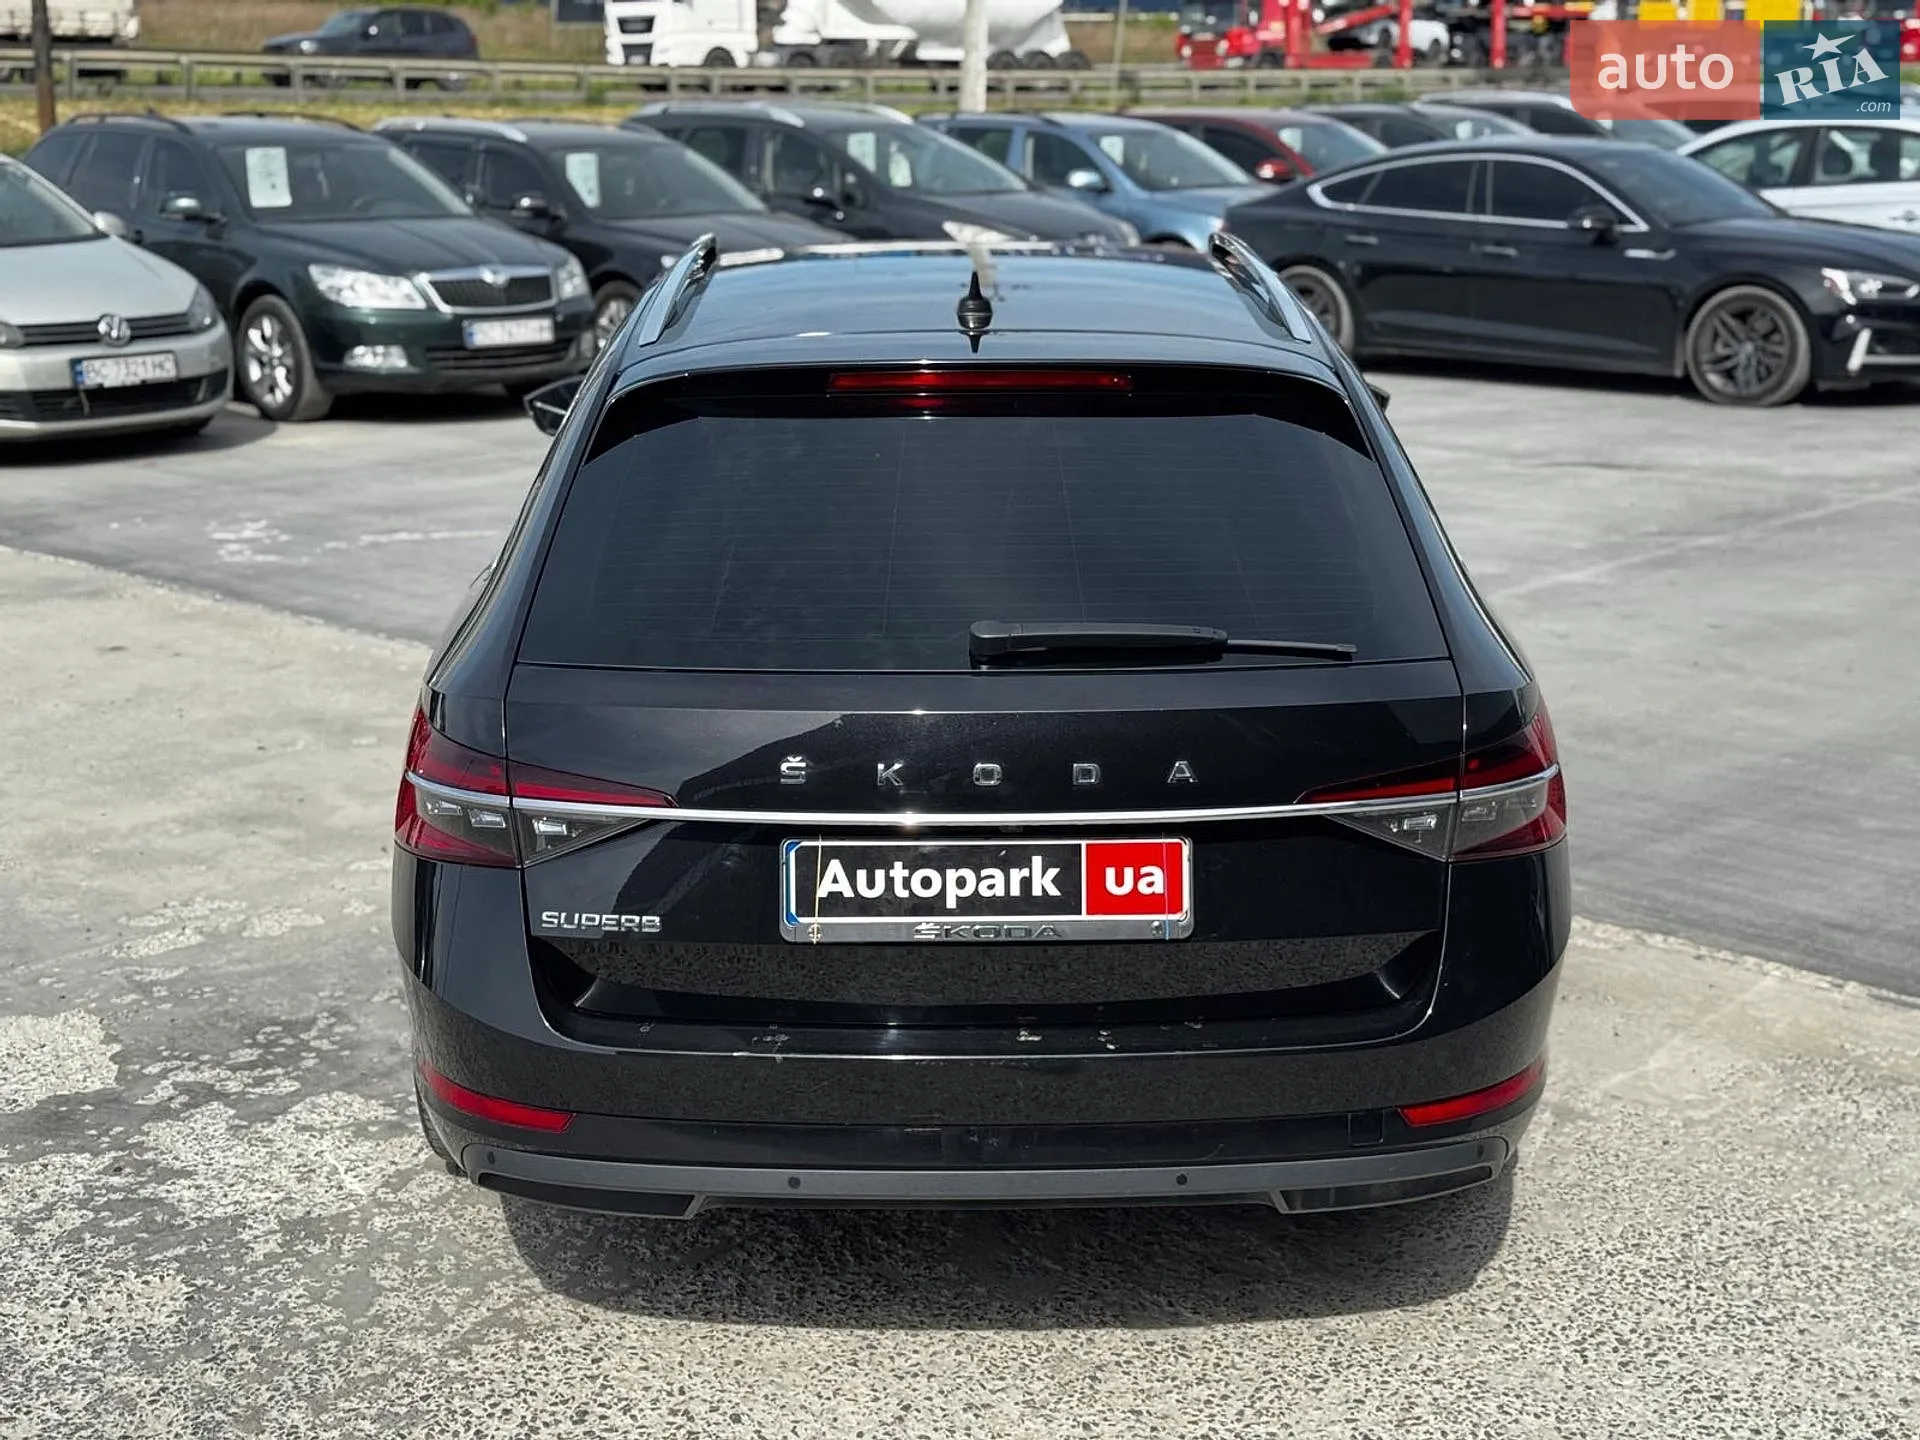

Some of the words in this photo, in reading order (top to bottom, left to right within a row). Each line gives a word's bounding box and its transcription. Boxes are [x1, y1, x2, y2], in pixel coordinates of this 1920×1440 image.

[779, 755, 1198, 786] ŠKODA
[818, 855, 1061, 908] Autopark
[1104, 865, 1165, 896] ua
[541, 911, 661, 932] SUPERB
